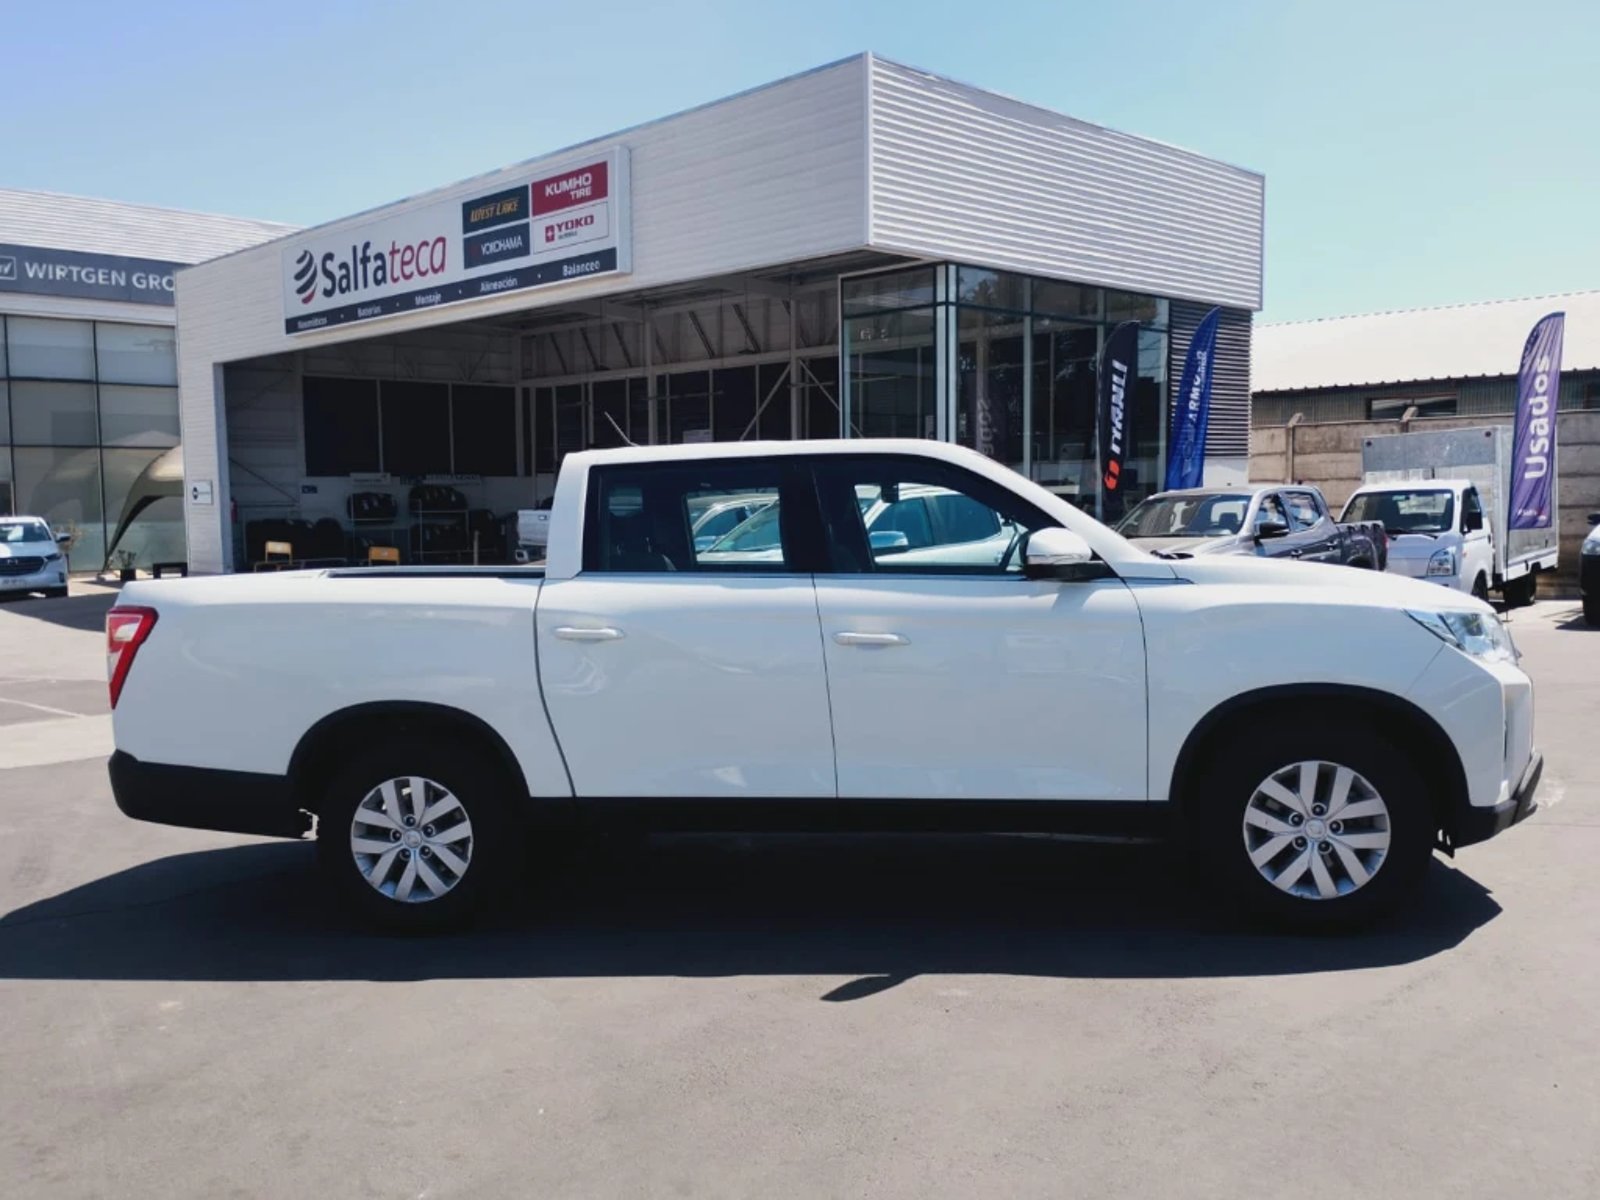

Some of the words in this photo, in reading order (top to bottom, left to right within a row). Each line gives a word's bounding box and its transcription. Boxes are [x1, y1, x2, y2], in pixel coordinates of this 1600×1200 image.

[545, 172, 592, 197] KUMHO
[570, 185, 592, 200] TIRE
[556, 214, 594, 232] YOKO
[481, 235, 523, 256] YOKOHAMA
[25, 261, 127, 287] WIRTGEN
[321, 236, 447, 298] Salfateca
[415, 291, 442, 306] Montaje
[480, 276, 518, 293] Alineación
[562, 260, 600, 277] Balanceo
[1524, 354, 1549, 481] Usados
